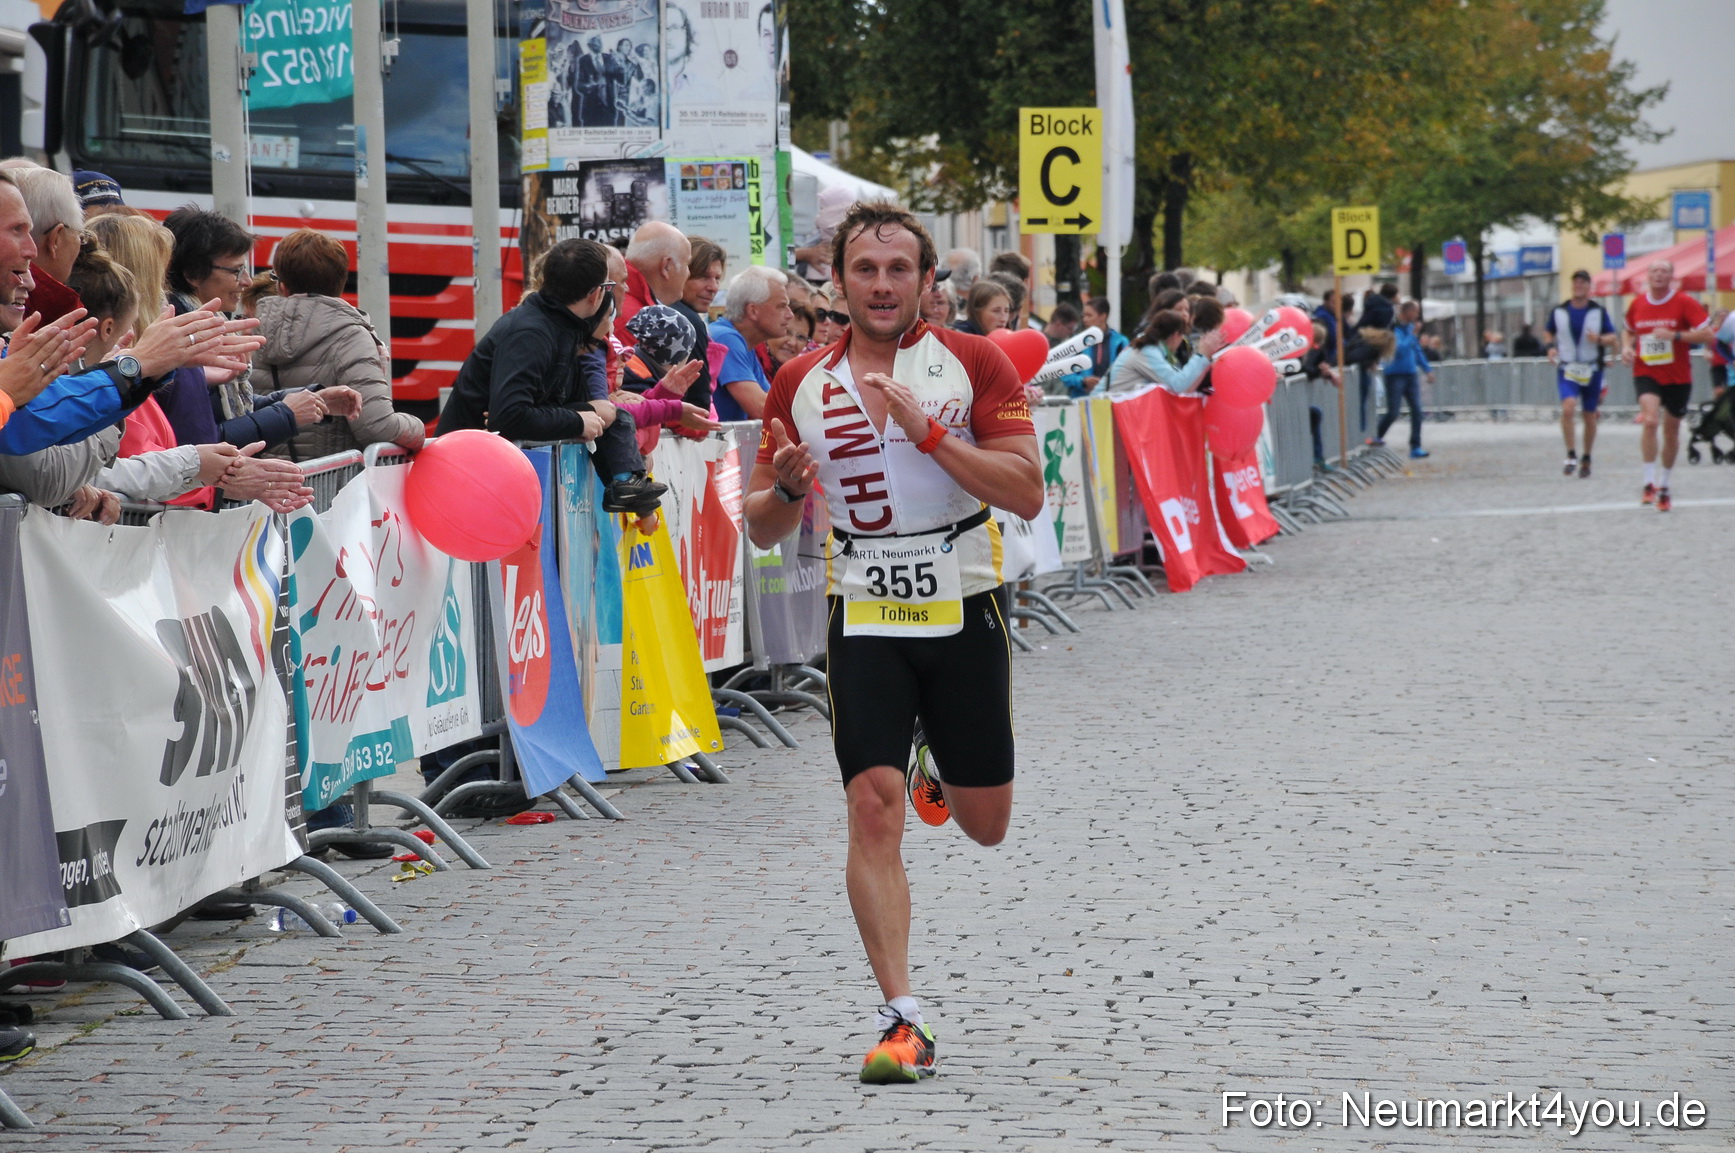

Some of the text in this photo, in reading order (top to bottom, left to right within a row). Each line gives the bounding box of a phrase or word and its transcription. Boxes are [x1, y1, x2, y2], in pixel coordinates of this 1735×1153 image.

[1030, 114, 1093, 135] Block
[1040, 146, 1081, 207] C
[553, 178, 579, 195] MARK
[547, 197, 579, 215] BENDER
[1338, 211, 1372, 224] Block
[1345, 229, 1366, 259] D
[849, 546, 936, 560] PARTL Neumarkt
[866, 562, 938, 600] 355
[879, 606, 929, 622] Tobias
